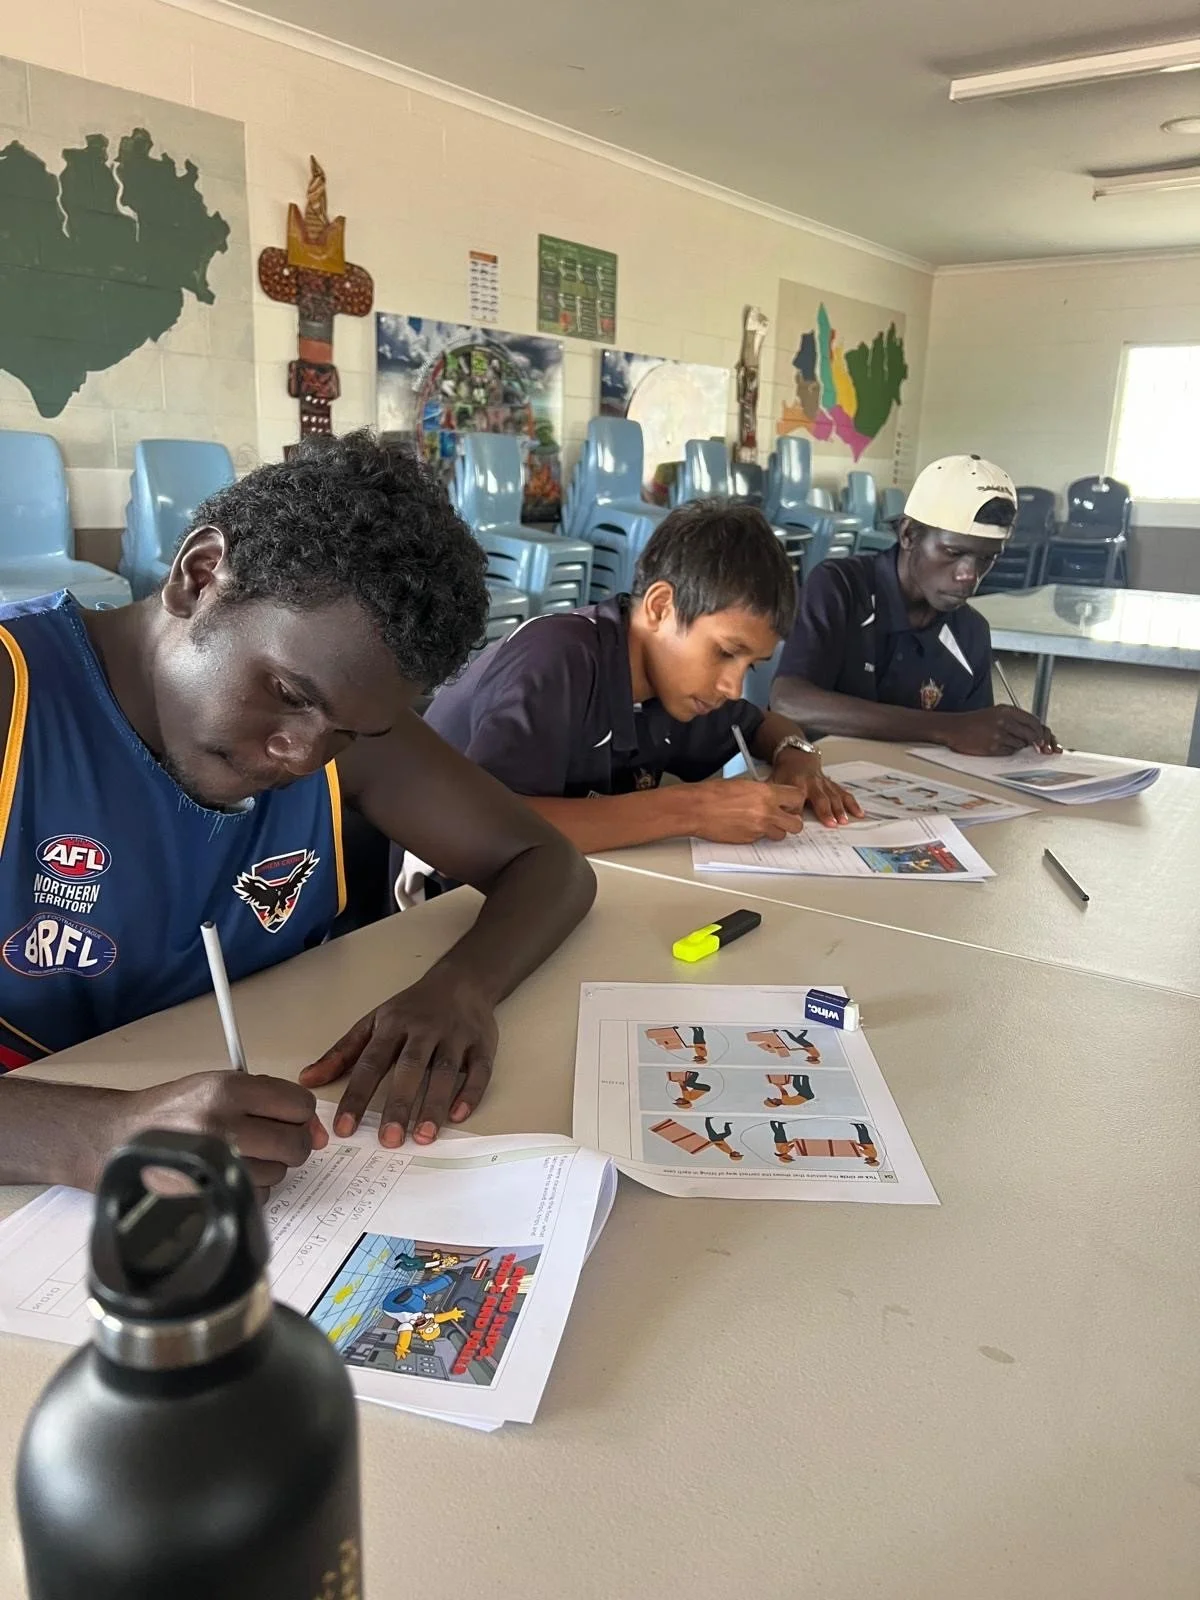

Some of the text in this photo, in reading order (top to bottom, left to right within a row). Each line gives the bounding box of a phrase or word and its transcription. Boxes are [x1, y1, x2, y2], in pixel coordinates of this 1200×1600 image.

[42, 843, 104, 871] AFL
[34, 873, 100, 903] NORTHERN
[34, 892, 94, 914] TERRITORY
[24, 919, 98, 968] BRFL
[807, 1003, 840, 1021] winc.
[499, 1266, 526, 1313] AVOID
[475, 1297, 498, 1329] AND
